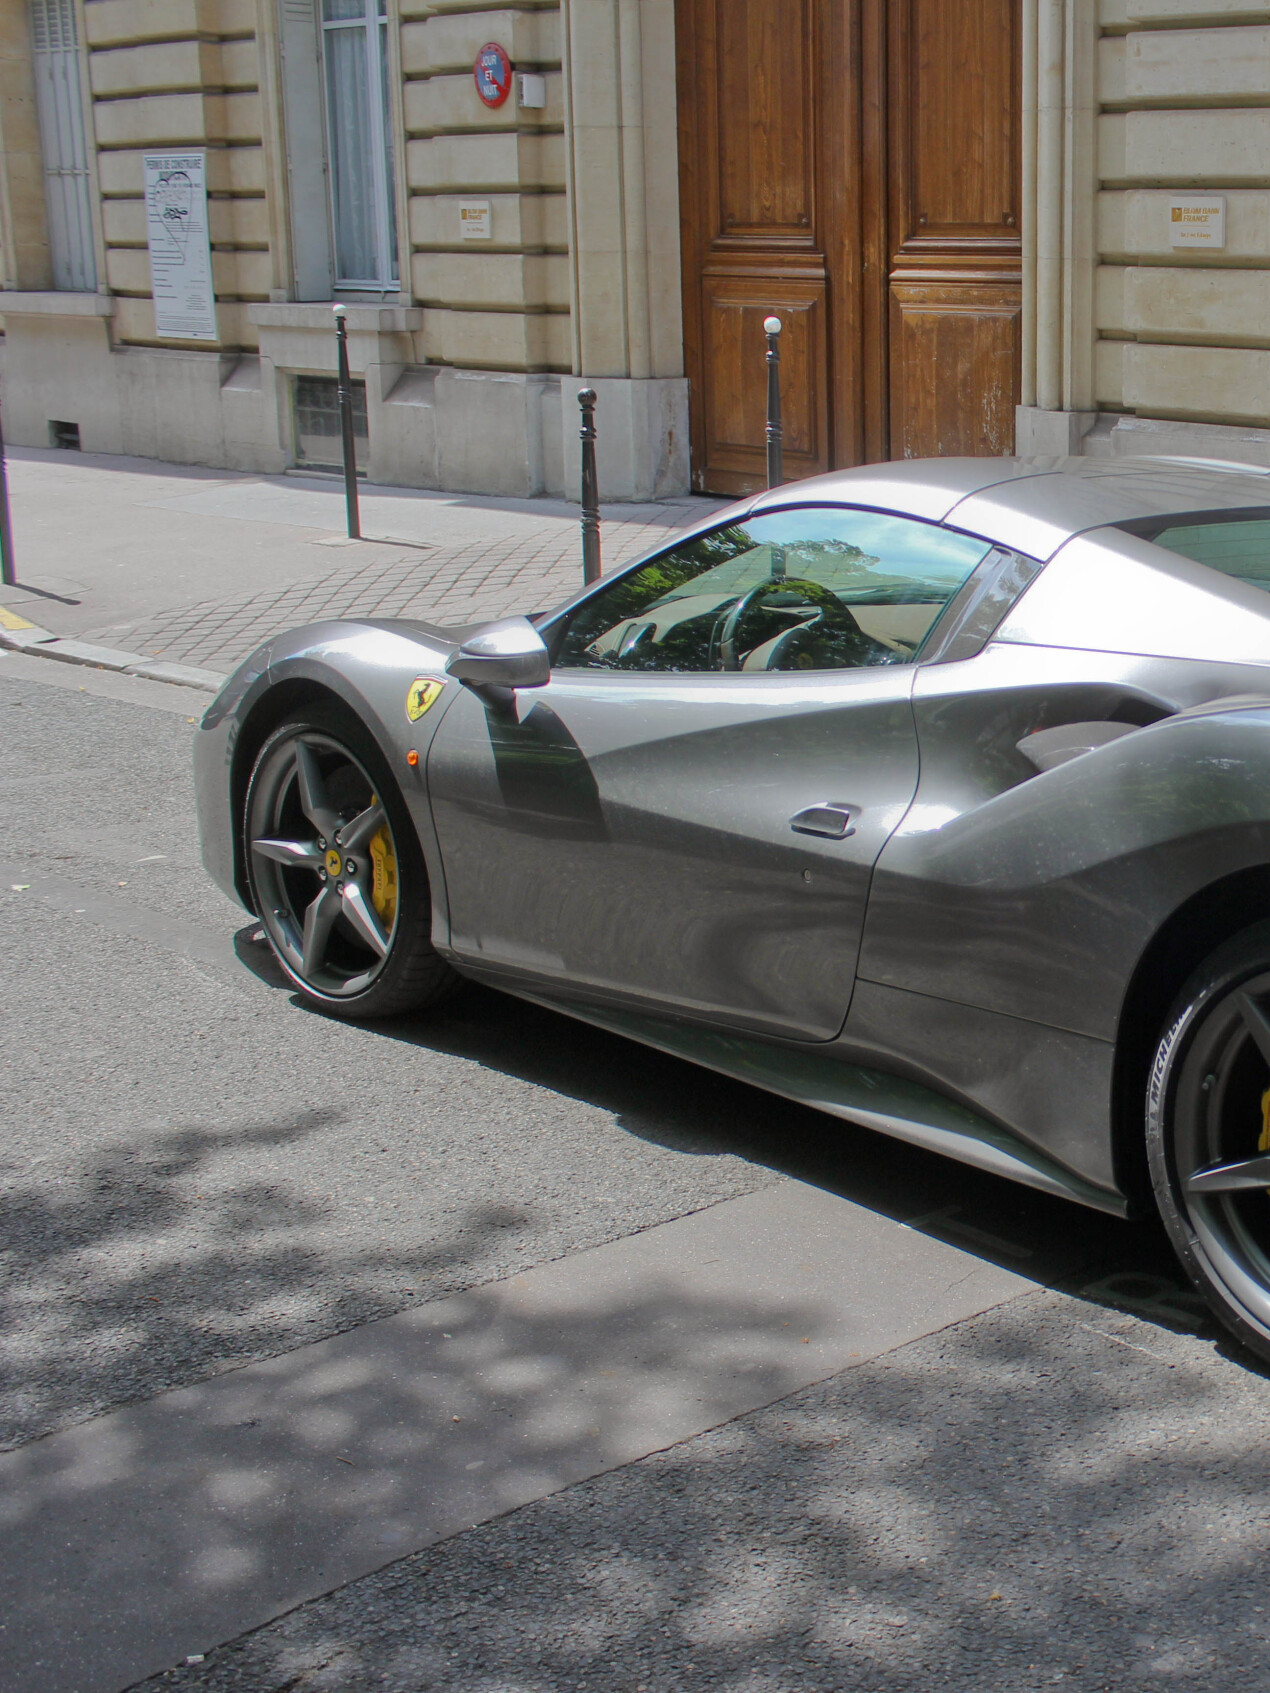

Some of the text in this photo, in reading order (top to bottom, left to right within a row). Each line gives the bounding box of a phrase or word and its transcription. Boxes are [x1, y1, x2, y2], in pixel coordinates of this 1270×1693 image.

[481, 54, 497, 67] JOUR
[484, 70, 493, 81] ET
[482, 84, 498, 97] NUIT
